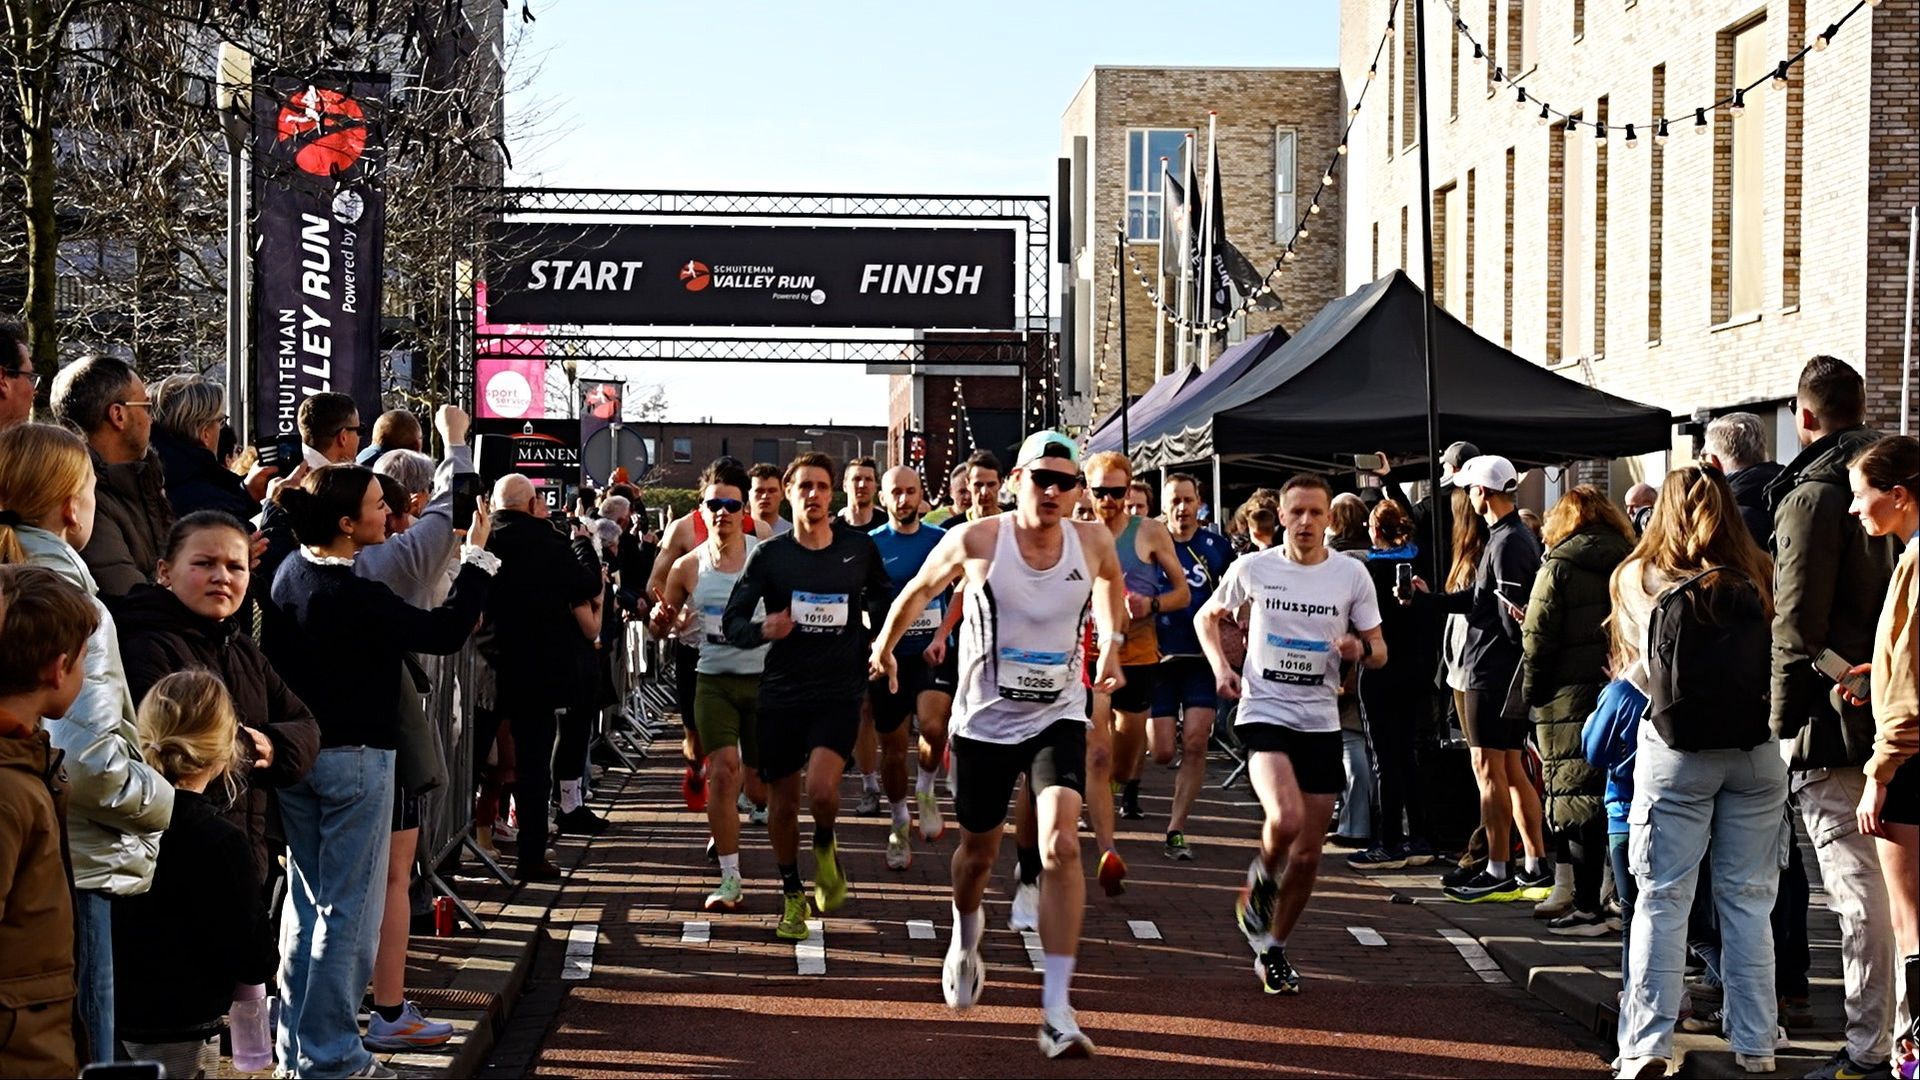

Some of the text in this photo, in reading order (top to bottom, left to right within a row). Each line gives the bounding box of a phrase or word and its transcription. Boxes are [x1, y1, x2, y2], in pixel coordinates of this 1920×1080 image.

[341, 228, 357, 245] by
[527, 260, 643, 291] START
[713, 265, 774, 274] SCHUITEMAN
[342, 250, 357, 313] Powered
[713, 275, 815, 289] VALLEY RUN
[859, 264, 983, 294] FINISH
[772, 292, 800, 300] Powered
[801, 292, 809, 301] by
[301, 213, 332, 399] LLEY RUN
[278, 309, 297, 436] CHUITEMAN
[518, 448, 578, 460] MANEN
[1265, 598, 1338, 617] titussport
[804, 614, 834, 624] 10180
[1280, 660, 1312, 672] 10168
